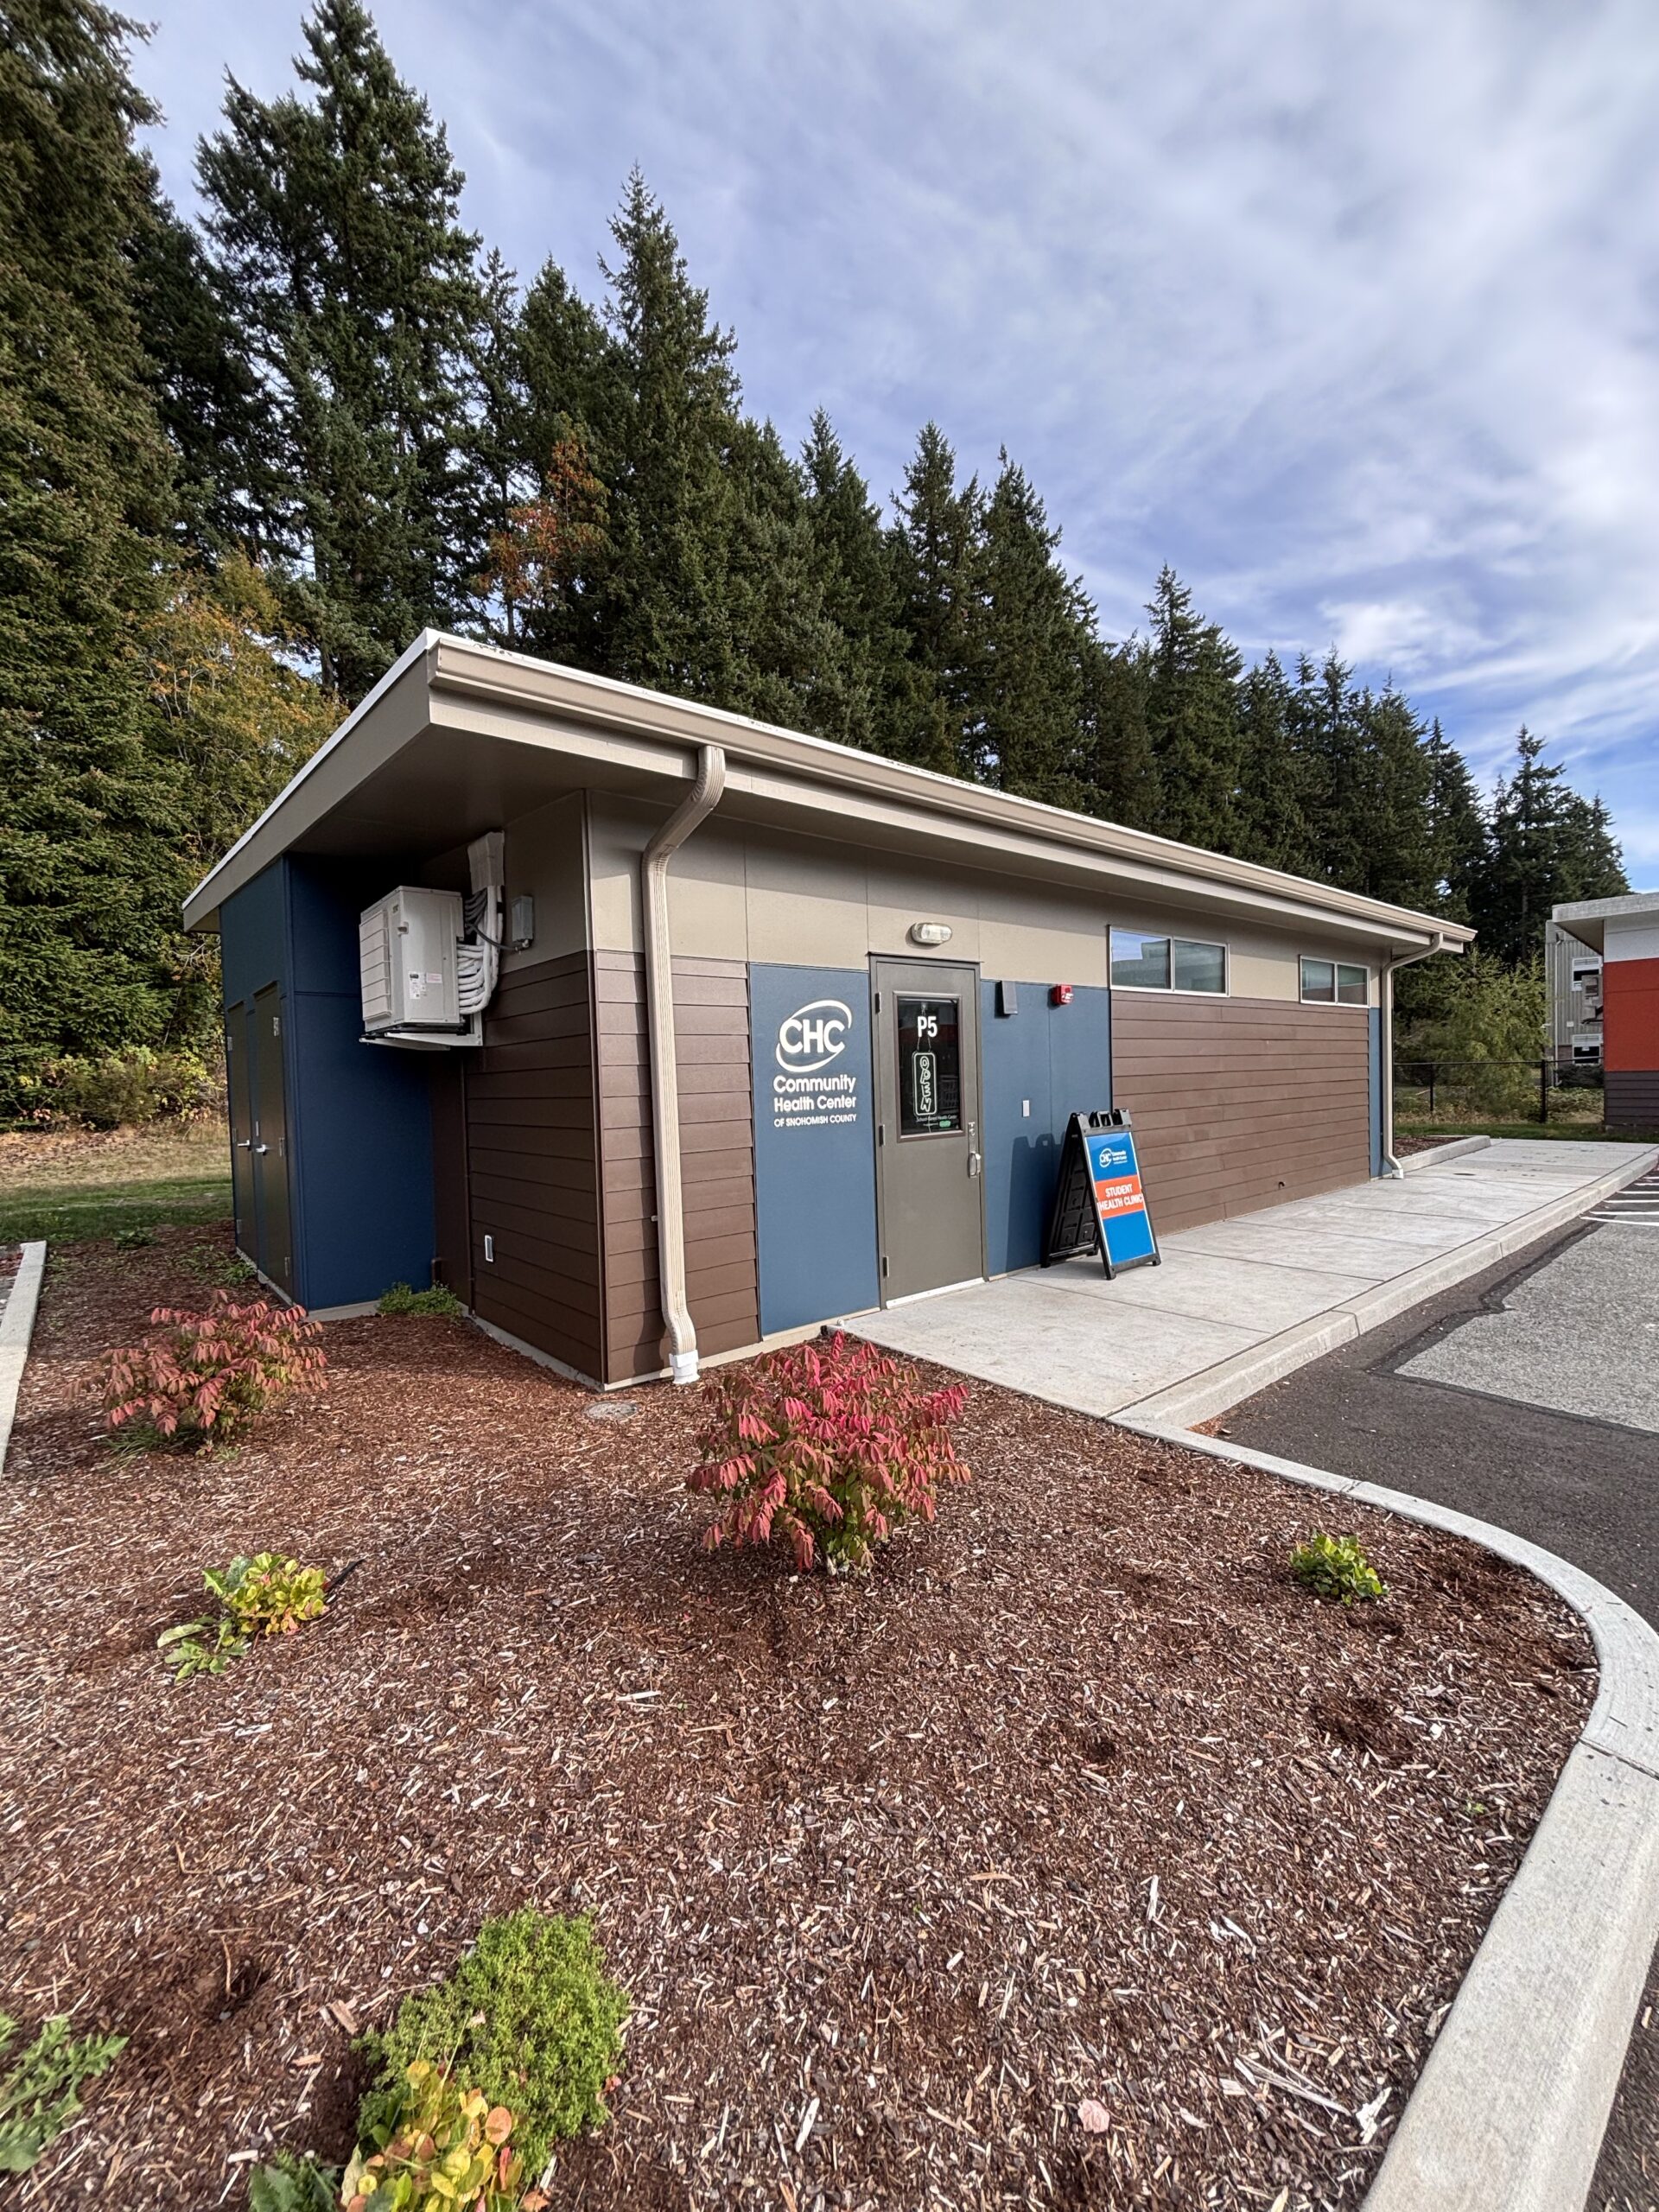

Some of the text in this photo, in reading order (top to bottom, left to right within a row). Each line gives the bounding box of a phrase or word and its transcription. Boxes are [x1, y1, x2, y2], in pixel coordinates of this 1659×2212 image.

[917, 1015, 938, 1038] P5
[779, 1019, 845, 1053] CHC
[773, 1074, 856, 1093] Community
[919, 1056, 931, 1112] OPEN
[774, 1095, 856, 1113] Health Center
[773, 1114, 856, 1128] OF SNOHOMISH COUNTY
[1105, 1184, 1133, 1198] STUDENT
[1099, 1193, 1143, 1211] HEALTH CLINIC
